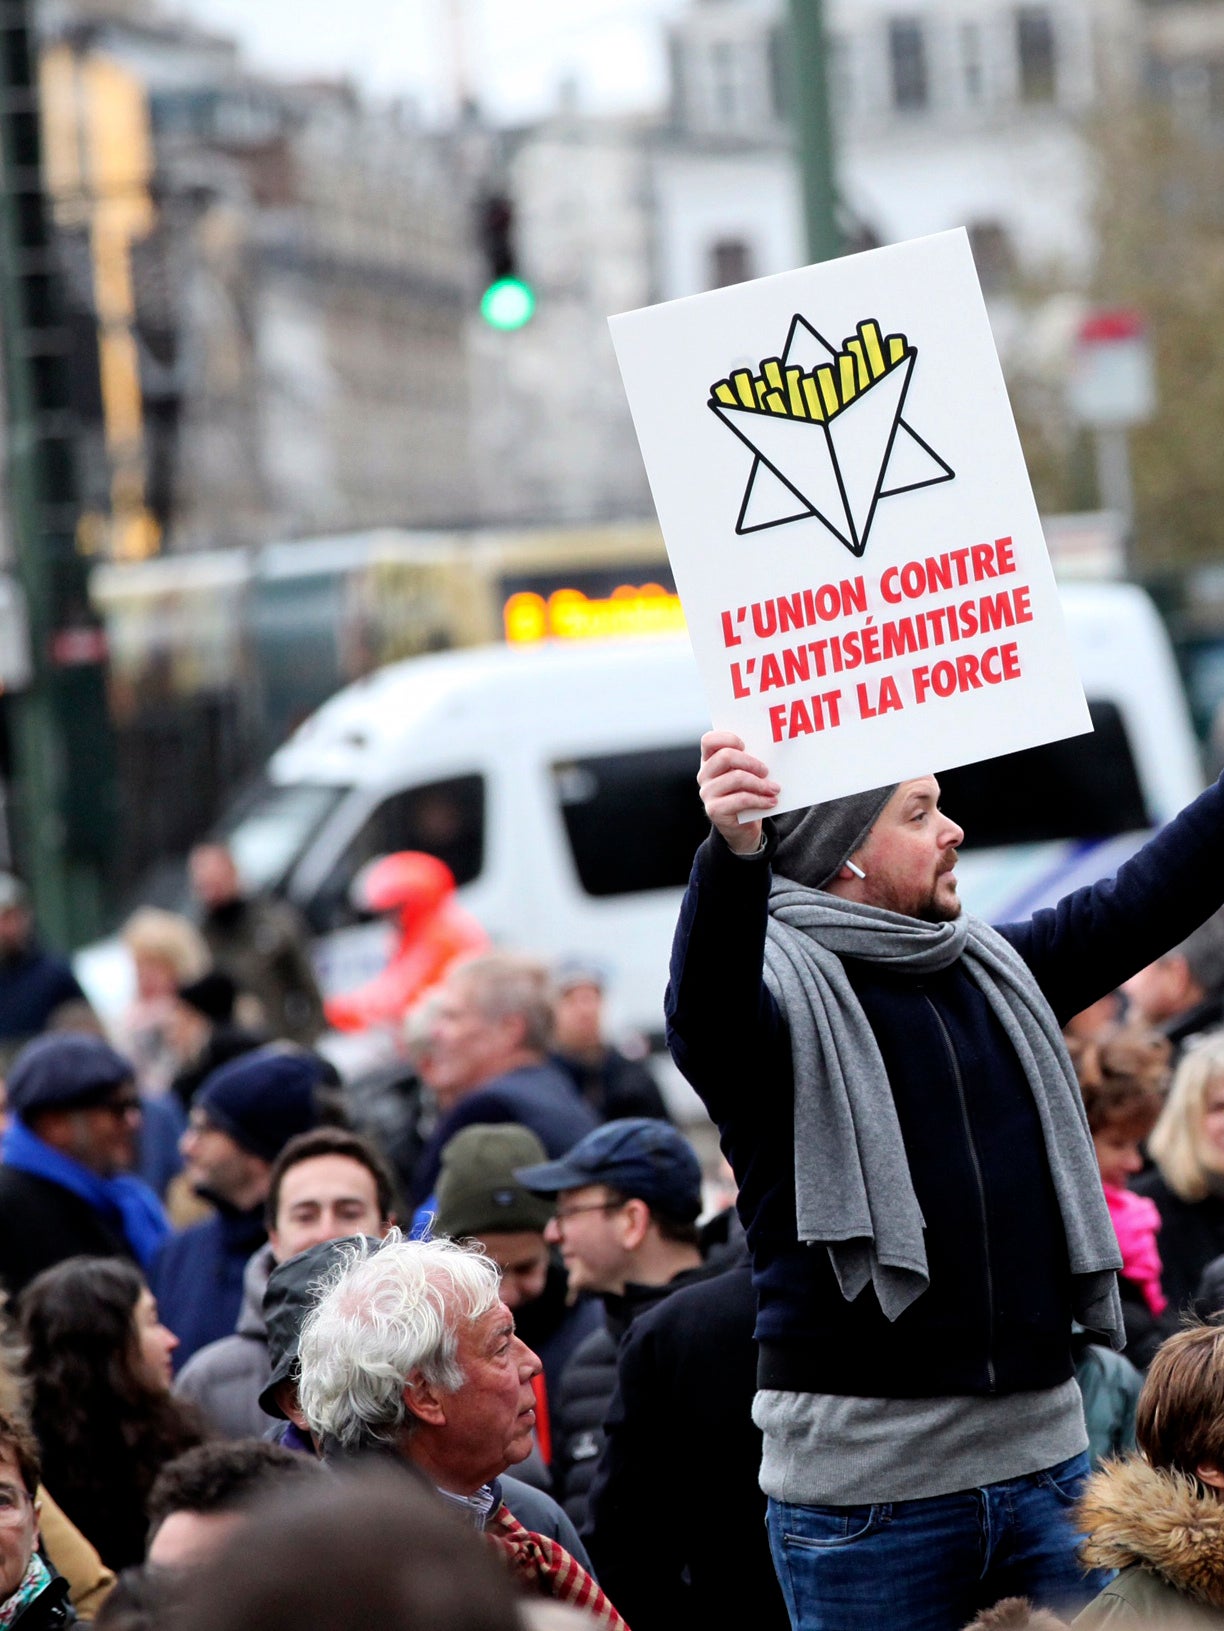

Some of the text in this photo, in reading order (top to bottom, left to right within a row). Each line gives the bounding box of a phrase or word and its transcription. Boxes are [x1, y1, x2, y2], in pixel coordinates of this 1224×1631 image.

[721, 576, 867, 648] L'UNION
[880, 536, 1016, 604] CONTRE
[730, 585, 1033, 699] L'ANTISÉMITISME
[769, 641, 1021, 743] FAIT LA FORCE
